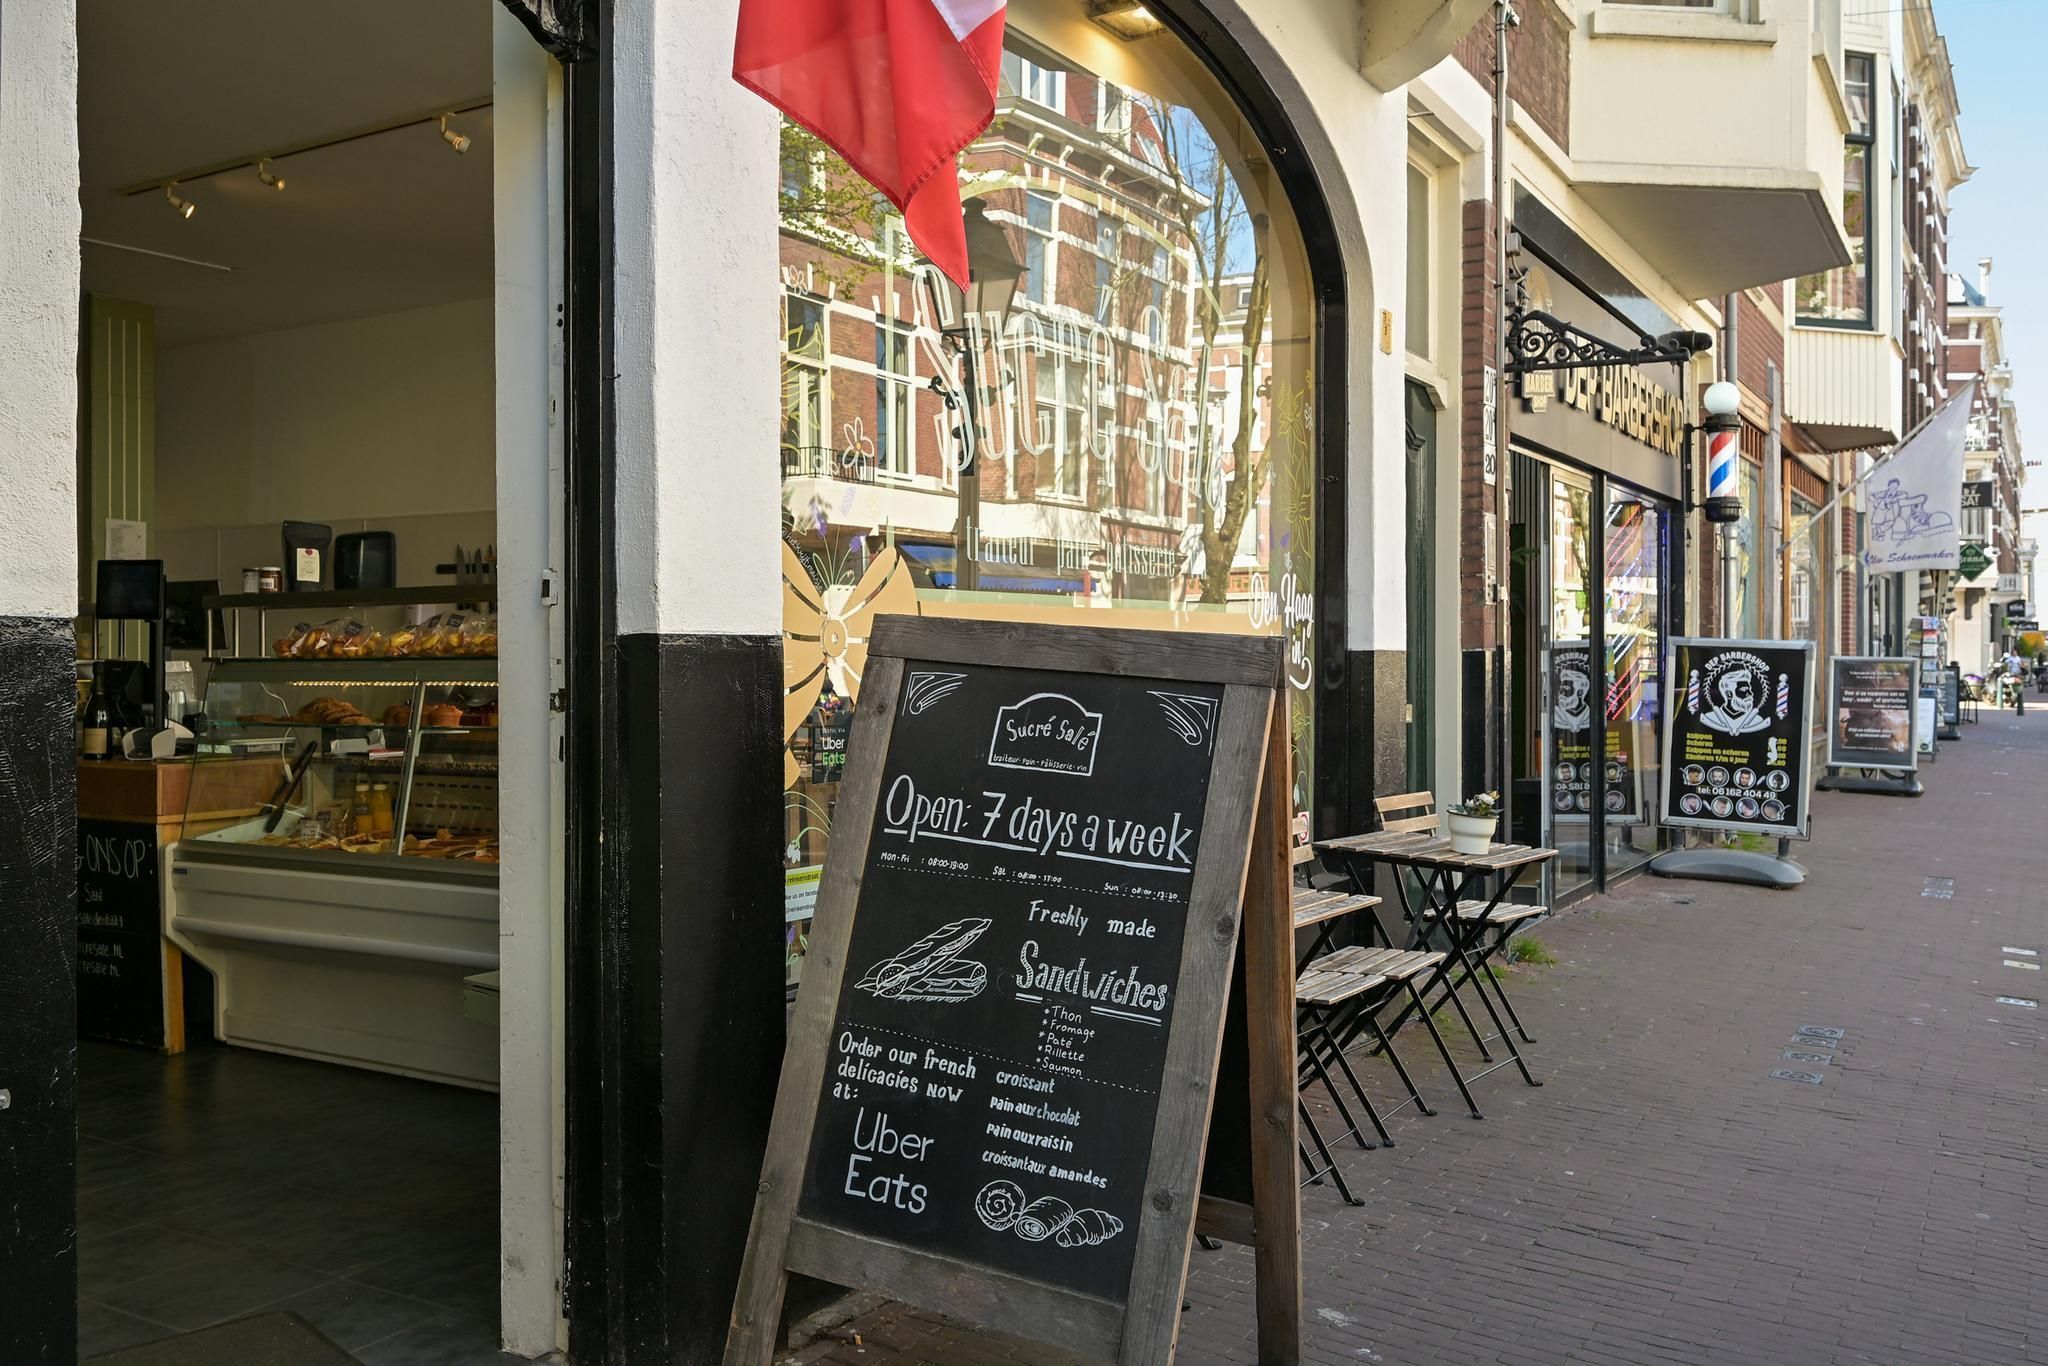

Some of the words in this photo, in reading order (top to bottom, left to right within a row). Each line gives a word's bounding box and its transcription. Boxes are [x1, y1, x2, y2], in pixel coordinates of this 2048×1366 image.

[912, 263, 1116, 473] Sucré
[1601, 357, 1684, 459] BARBERSHOP
[1888, 549, 1955, 563] Schoenmaker
[1249, 572, 1279, 630] Den
[1280, 572, 1315, 639] Haag
[1705, 656, 1720, 671] DEP
[1720, 651, 1770, 672] BARBERSHOP
[822, 736, 846, 750] Uber
[1006, 715, 1057, 742] Sucré
[1055, 719, 1096, 751] Salé
[822, 752, 846, 766] Eats
[1076, 763, 1088, 772] vin
[982, 791, 1006, 838] 7
[1008, 796, 1077, 855] days
[1081, 815, 1100, 851] a
[1107, 812, 1194, 864] week
[86, 834, 122, 875] ONS
[992, 865, 1007, 876] Sat
[1103, 882, 1119, 891] Sun
[1028, 899, 1089, 936] Freshly
[1106, 918, 1156, 938] made
[1015, 939, 1168, 1011] Sandwiches
[1051, 1005, 1082, 1023] Thon
[1046, 1032, 1073, 1049] Paté
[1050, 1019, 1095, 1043] Fromage
[839, 1031, 883, 1058] Order
[888, 1048, 918, 1065] our
[924, 1048, 977, 1079] french
[1044, 1045, 1085, 1062] Rillette
[837, 1056, 919, 1093] delicacies
[1041, 1057, 1082, 1076] Saumon
[832, 1082, 859, 1100] at:
[996, 1071, 1056, 1093] croissant
[853, 1106, 935, 1162] Uber
[844, 1153, 928, 1214] Eats
[1049, 1164, 1107, 1189] amandes
